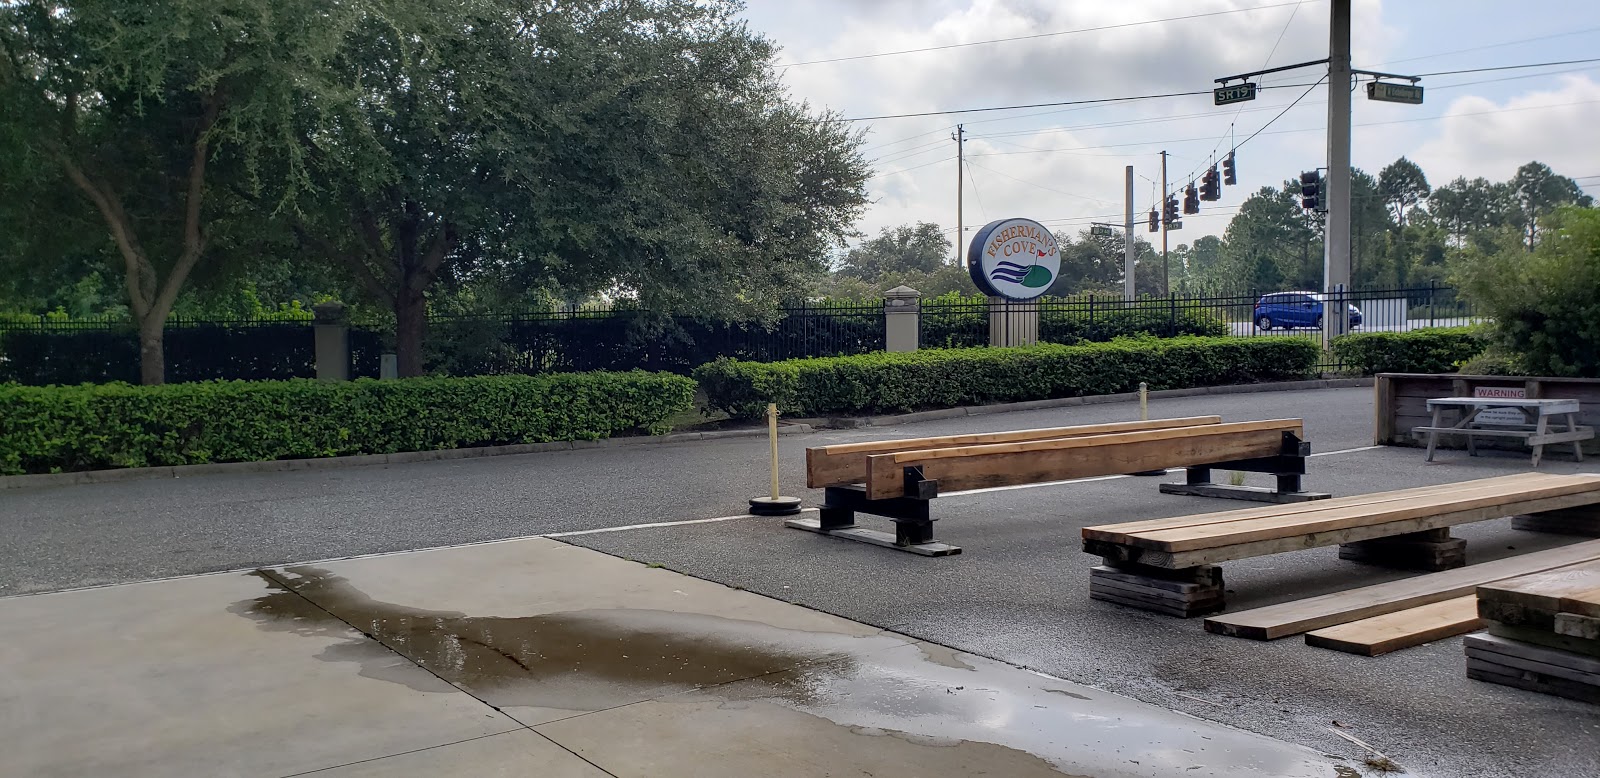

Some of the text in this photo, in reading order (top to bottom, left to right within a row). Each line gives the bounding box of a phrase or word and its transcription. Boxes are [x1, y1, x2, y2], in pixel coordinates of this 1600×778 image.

[1218, 87, 1249, 100] SR 19
[987, 226, 1057, 258] FISHERMAN'S
[1004, 241, 1037, 257] COVE
[1478, 389, 1525, 398] WARNING
